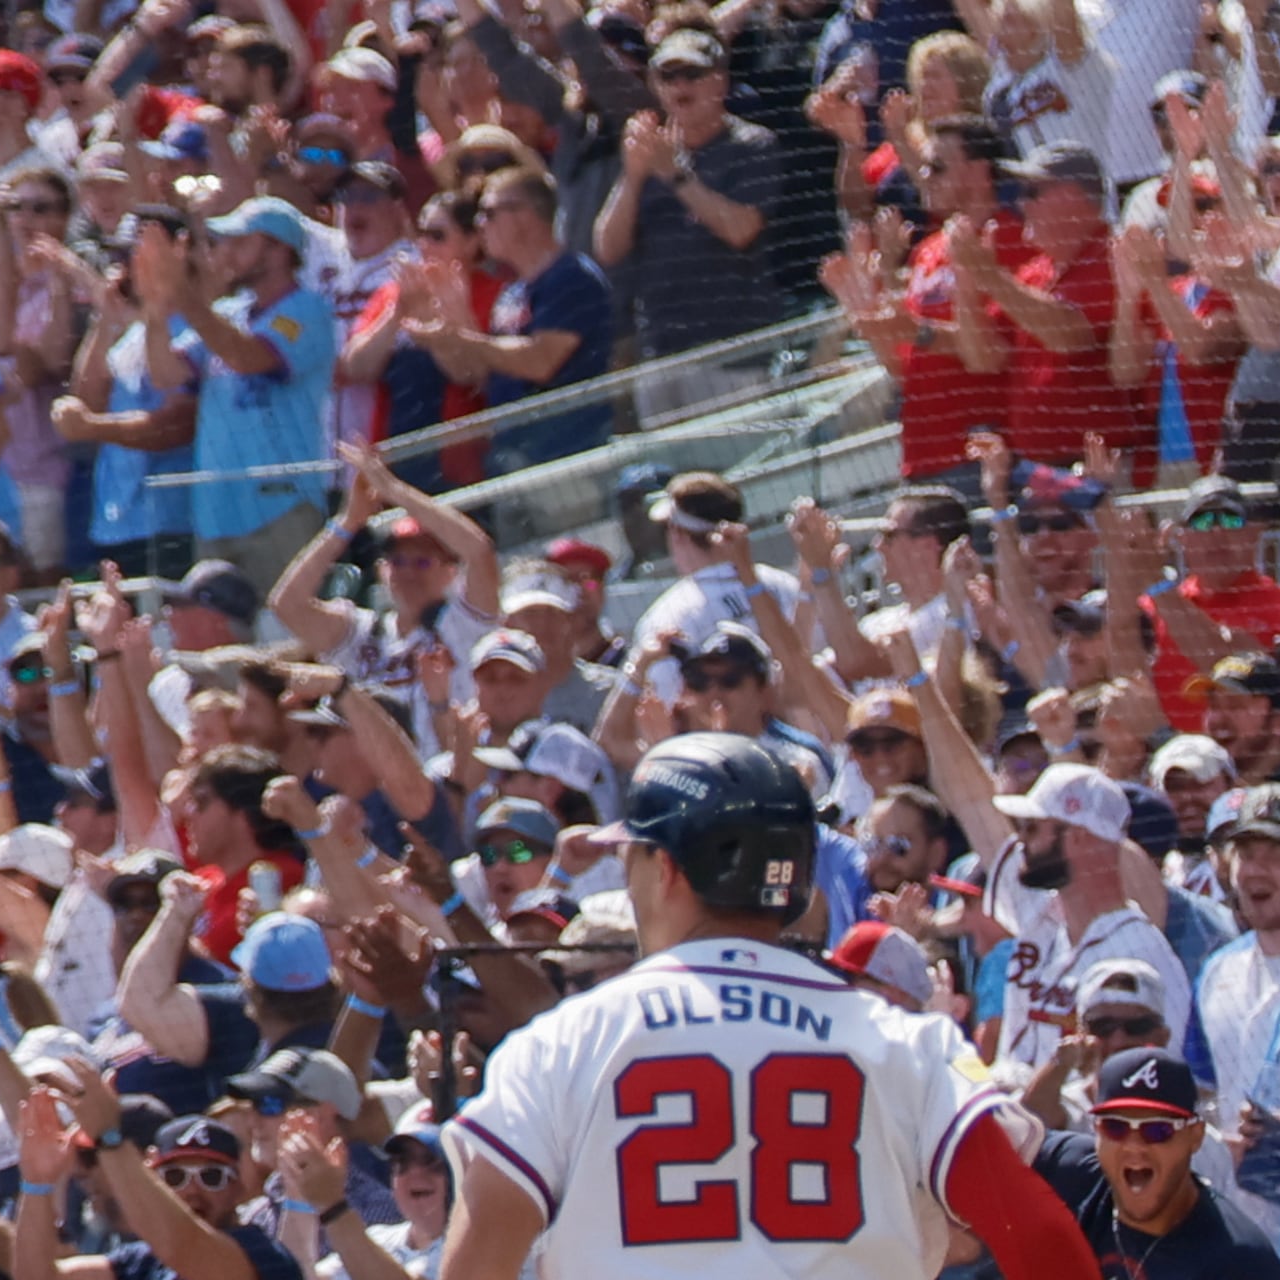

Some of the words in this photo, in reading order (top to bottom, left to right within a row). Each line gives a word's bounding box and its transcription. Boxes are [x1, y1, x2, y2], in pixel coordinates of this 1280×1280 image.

[645, 766, 709, 800] STRAUSS
[767, 860, 794, 885] 28
[637, 983, 833, 1042] OLSON
[613, 1052, 867, 1248] 28
